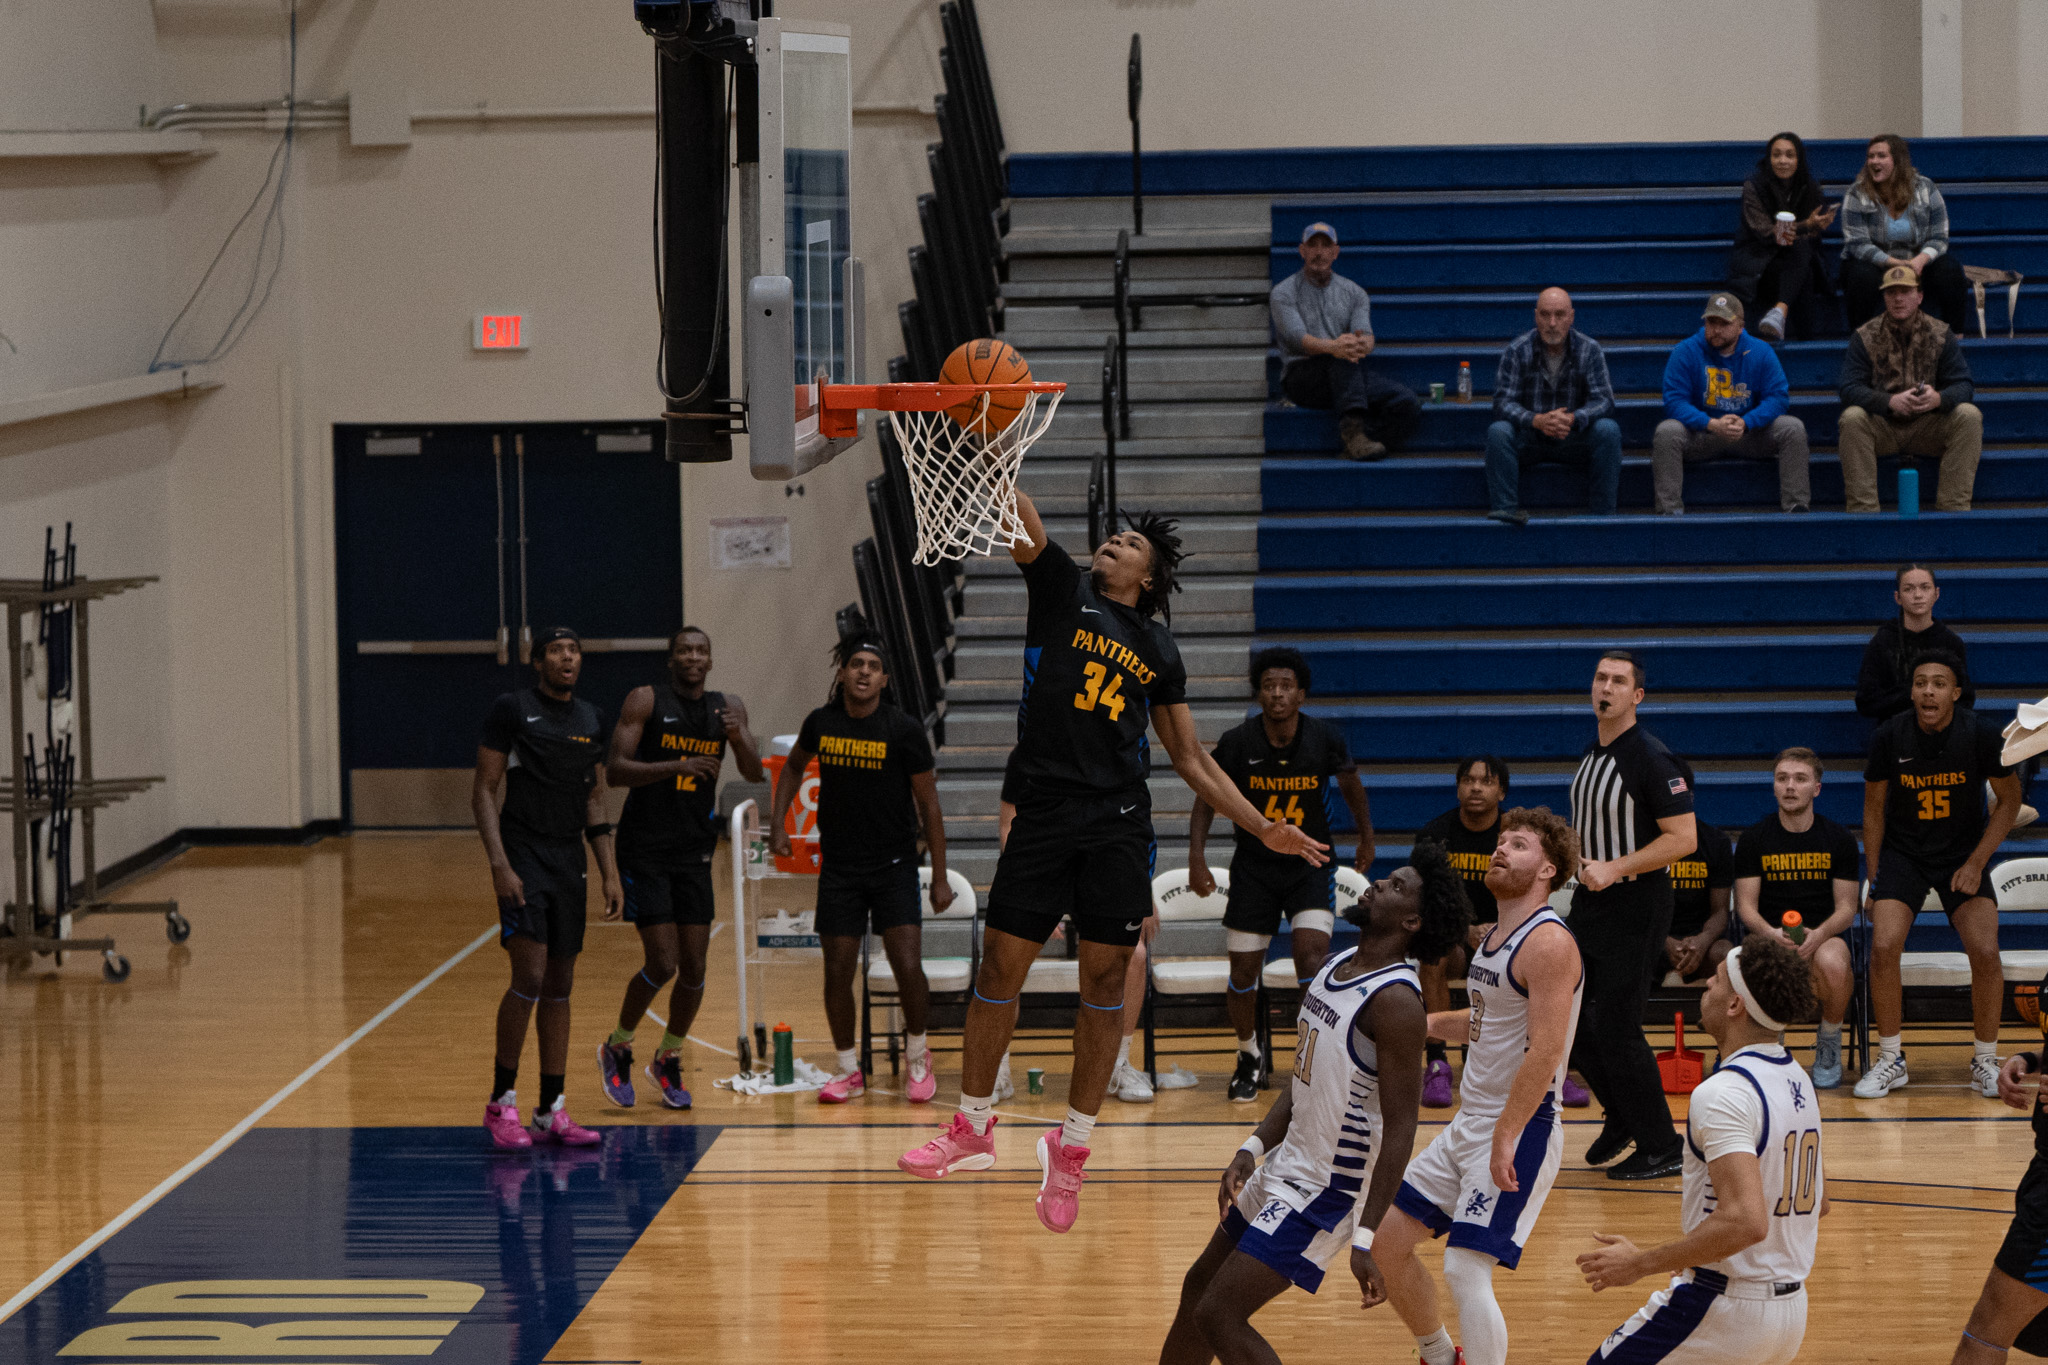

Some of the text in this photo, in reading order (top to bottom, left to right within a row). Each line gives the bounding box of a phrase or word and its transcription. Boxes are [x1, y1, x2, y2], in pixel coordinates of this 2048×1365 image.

[483, 315, 522, 348] EXIT
[1072, 628, 1157, 685] PANTHERS
[1074, 661, 1126, 721] 34
[819, 735, 887, 759] PANTHERS
[1250, 775, 1319, 791] PANTHERS
[1901, 771, 1967, 789] PANTHERS
[1264, 795, 1305, 827] 44
[1917, 790, 1950, 820] 35
[1762, 853, 1832, 871] PANTHERS
[1767, 871, 1828, 881] BASKETBALL
[1773, 1128, 1819, 1217] 10
